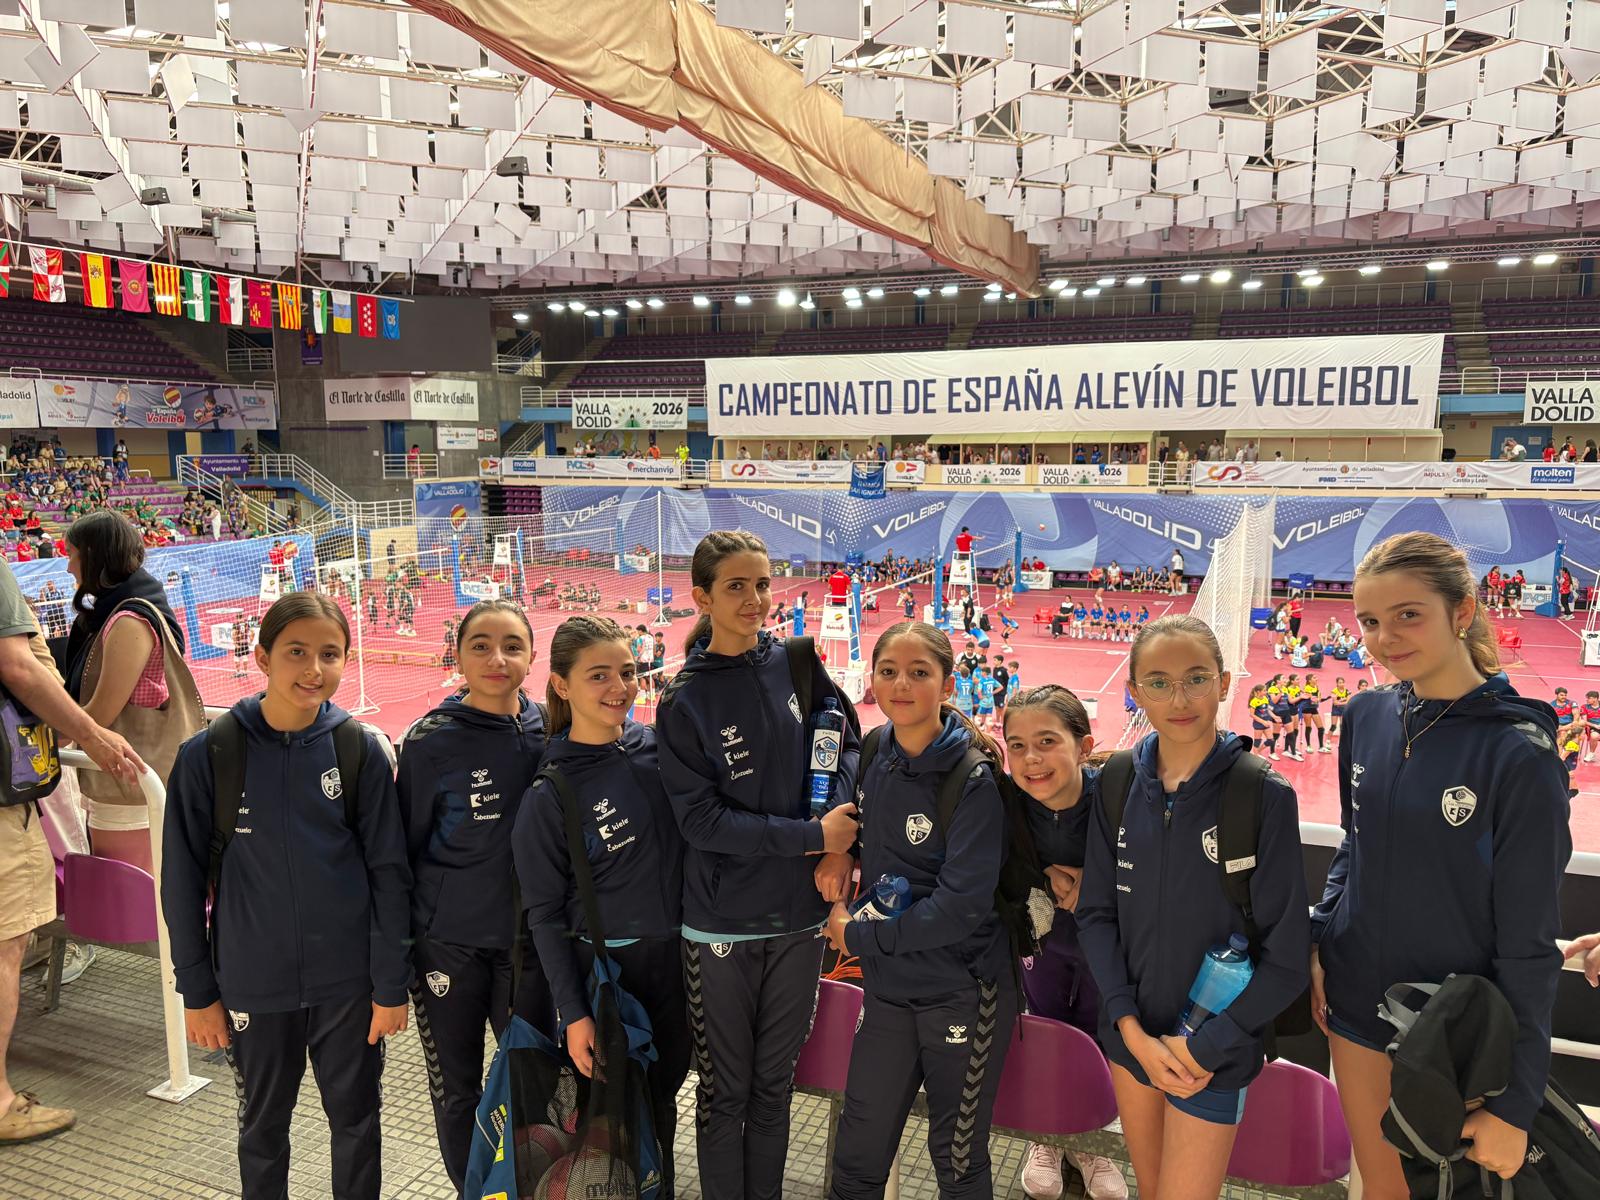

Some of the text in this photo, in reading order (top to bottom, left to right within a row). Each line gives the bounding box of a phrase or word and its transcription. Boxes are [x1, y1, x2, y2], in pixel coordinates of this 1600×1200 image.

[719, 363, 1419, 416] CAMPEONATO DE ESPAÑA ALEVÍN DE VOLEIBOL
[329, 389, 406, 404] El Norte de Castilla
[413, 391, 475, 405] El Norte de Castilla
[1532, 388, 1594, 404] VALLA
[575, 403, 683, 415] VALLA 2026
[1531, 406, 1594, 422] DOLID
[576, 416, 612, 428] DOLID
[633, 465, 674, 474] merchanvip
[947, 468, 1021, 476] VALLA 2026
[1043, 468, 1069, 476] VALLA
[1533, 468, 1572, 477] molten
[947, 476, 972, 484] DOLID
[1043, 476, 1070, 484] DOLID
[735, 494, 822, 539] VALLADOLID
[872, 501, 947, 538] VOLEIBOL
[1093, 499, 1202, 551] VALLADOLID
[1268, 507, 1365, 550] VOLEIBOL
[733, 750, 750, 761] kiele
[238, 806, 250, 814] ele
[611, 818, 629, 831] kiele
[1229, 860, 1253, 872] FILA
